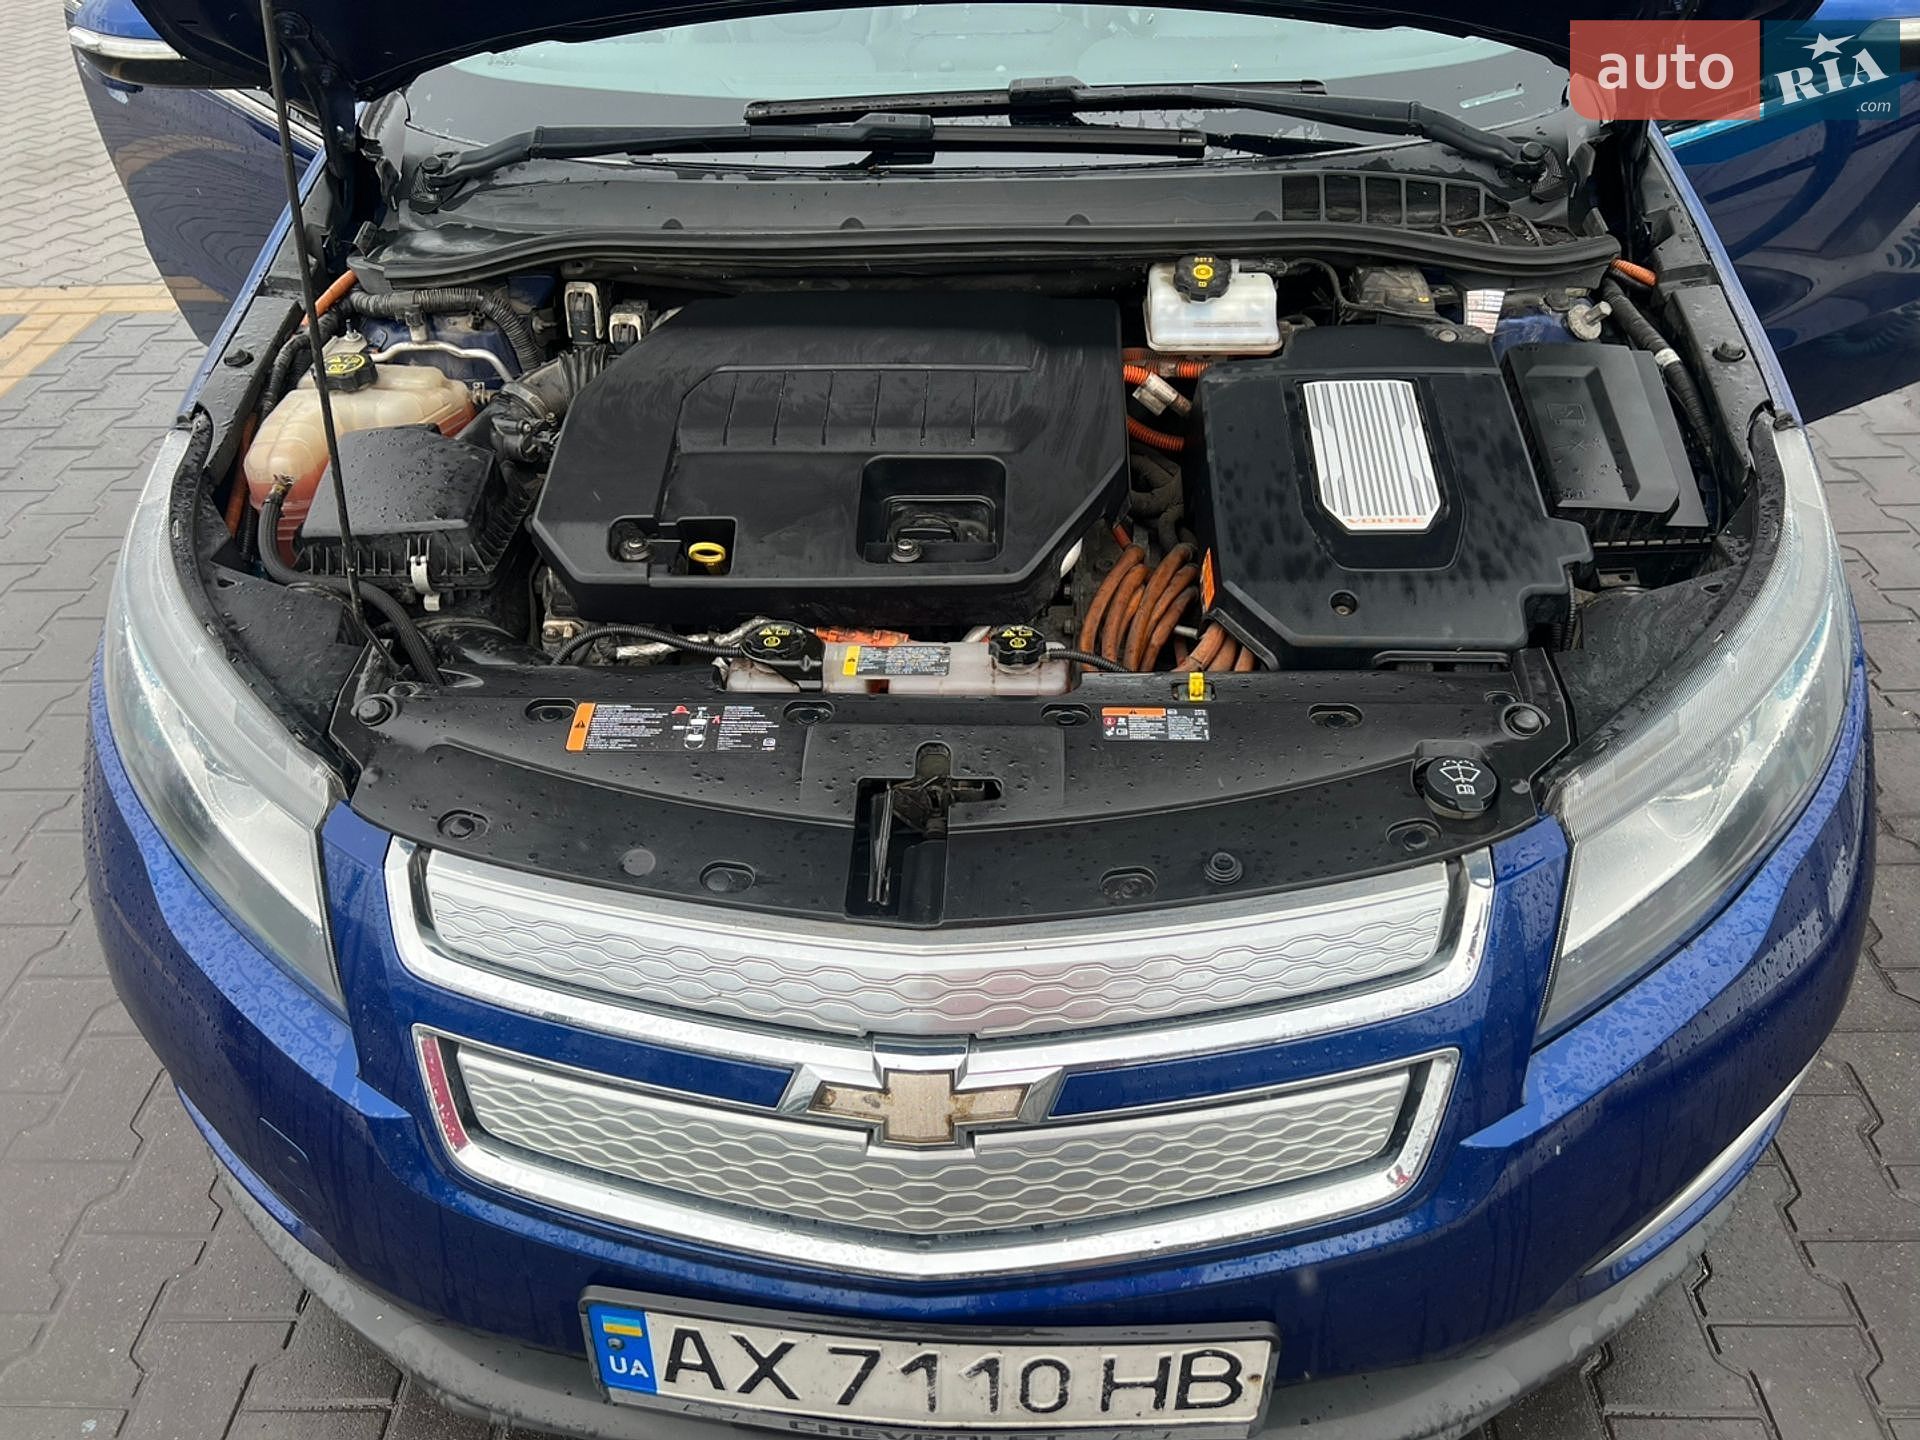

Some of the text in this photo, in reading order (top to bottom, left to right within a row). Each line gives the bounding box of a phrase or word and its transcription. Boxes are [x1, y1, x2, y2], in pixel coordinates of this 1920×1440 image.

[609, 1355, 649, 1378] UA
[663, 1328, 1245, 1414] AX 7110 HB
